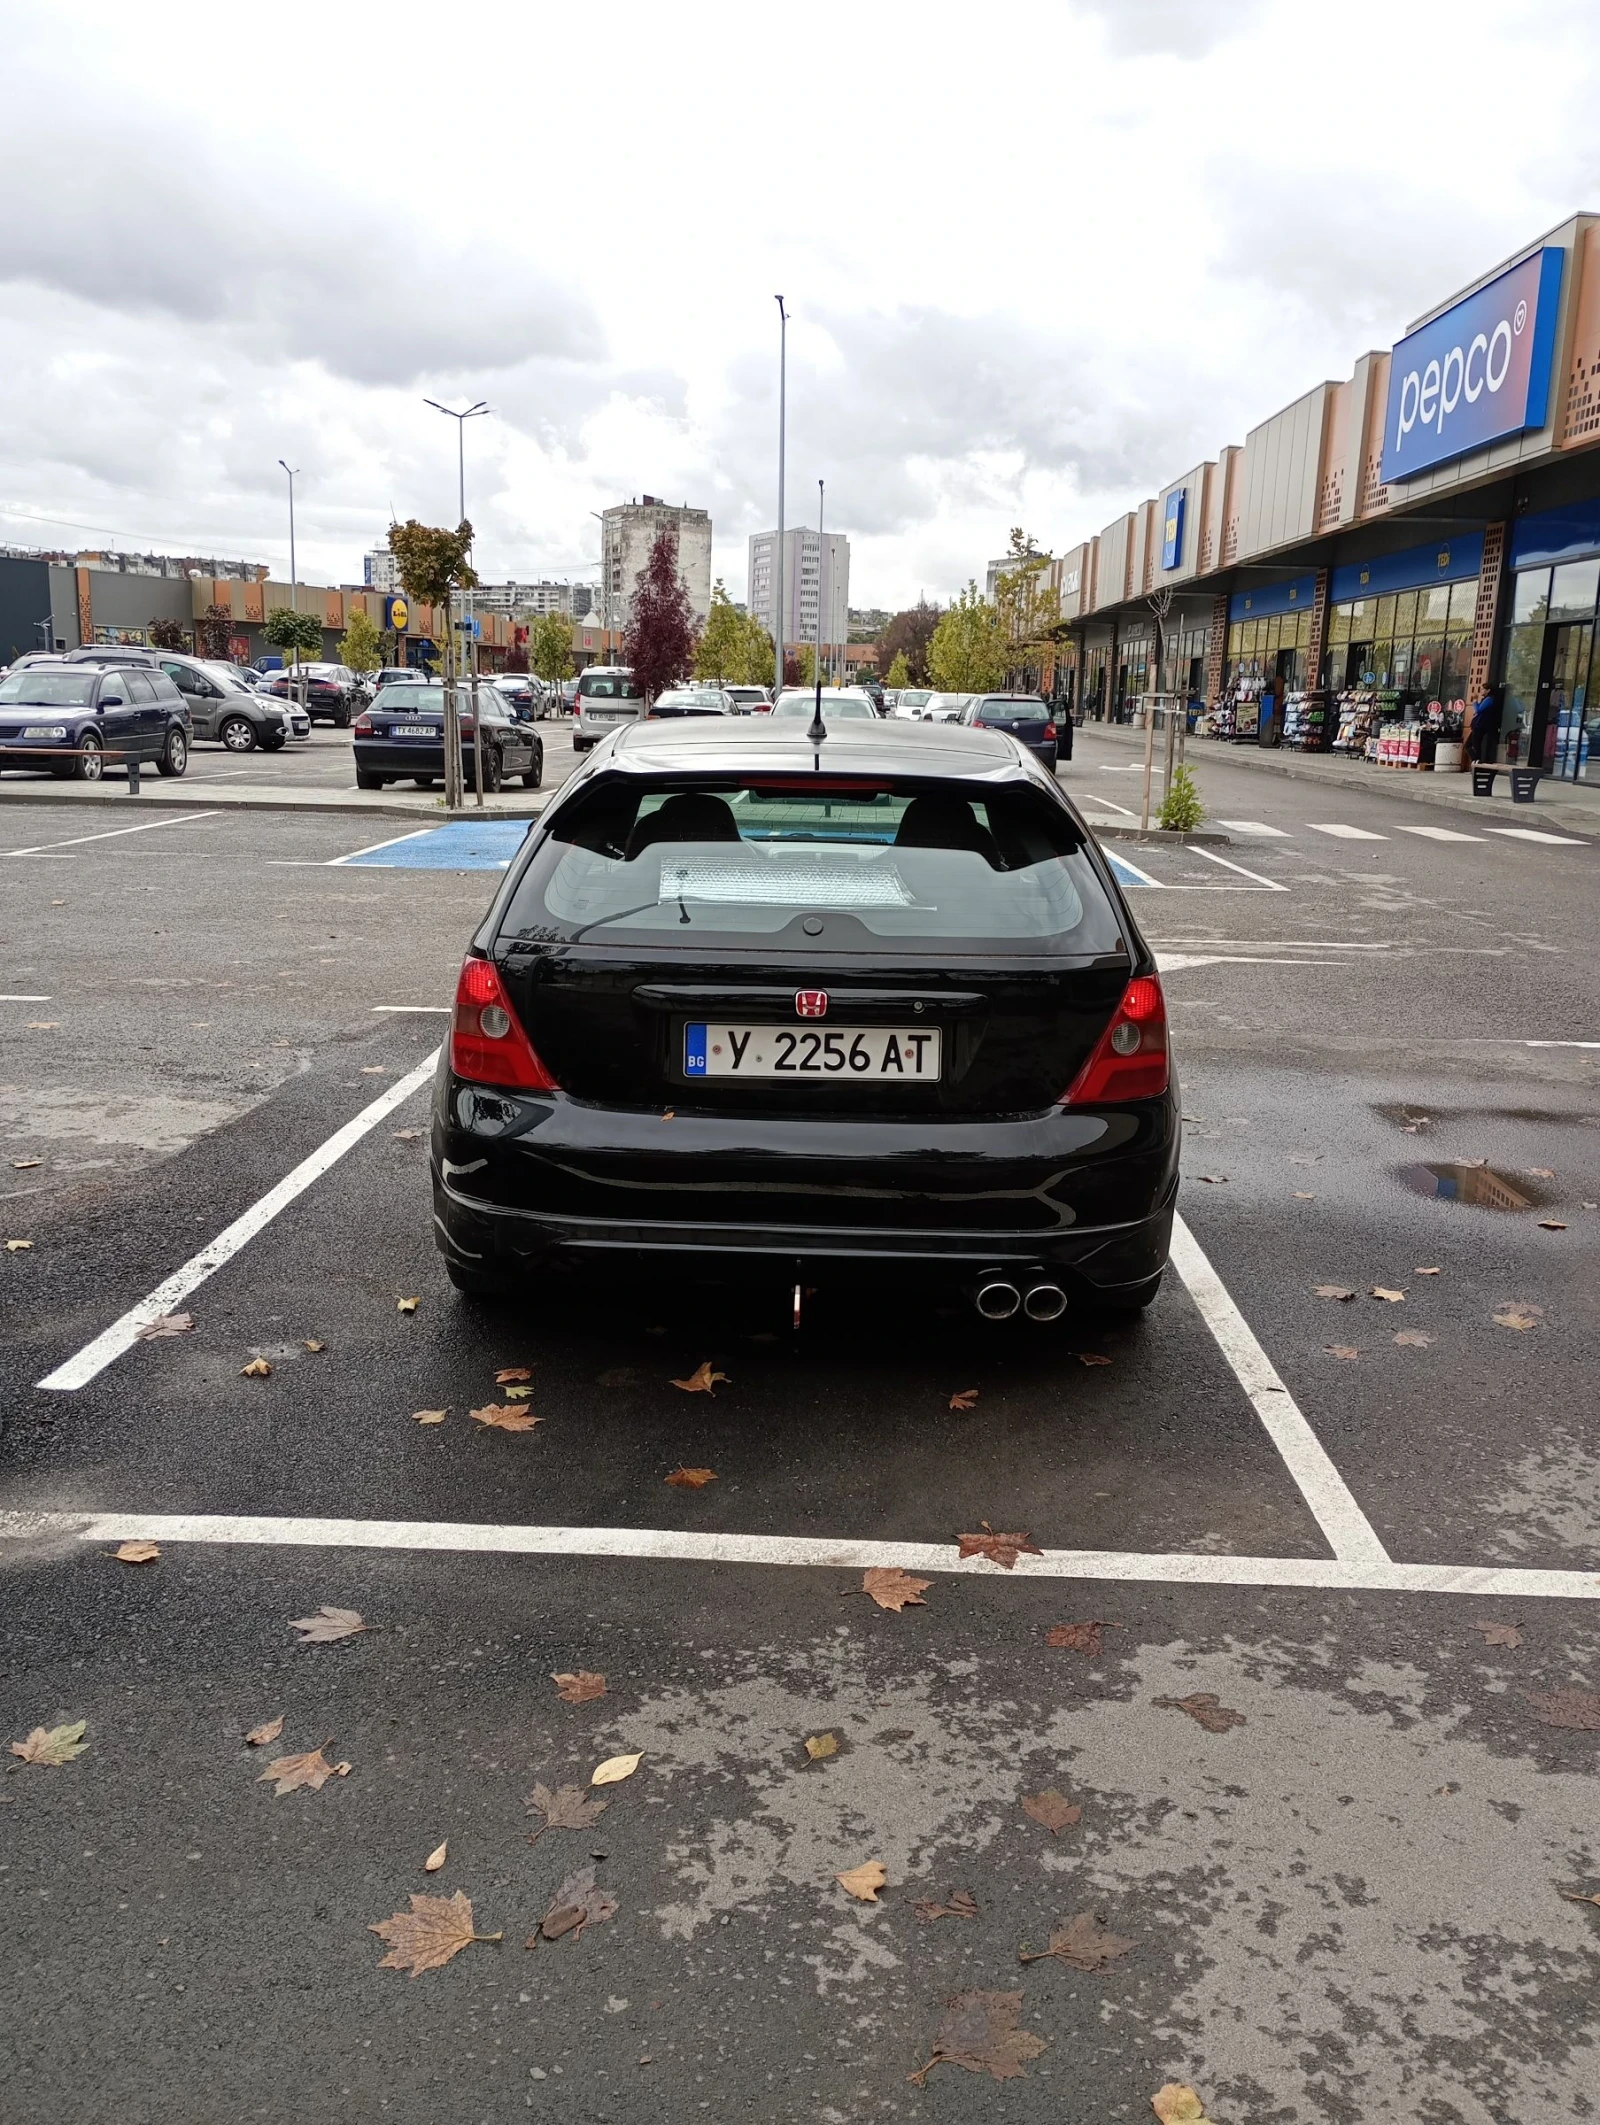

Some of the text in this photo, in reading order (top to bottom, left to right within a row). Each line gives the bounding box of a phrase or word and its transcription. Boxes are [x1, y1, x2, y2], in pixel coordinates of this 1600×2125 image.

[1396, 319, 1512, 452] pepco
[688, 1055, 705, 1068] BG
[774, 1031, 871, 1072] 2256
[880, 1034, 932, 1073] AT
